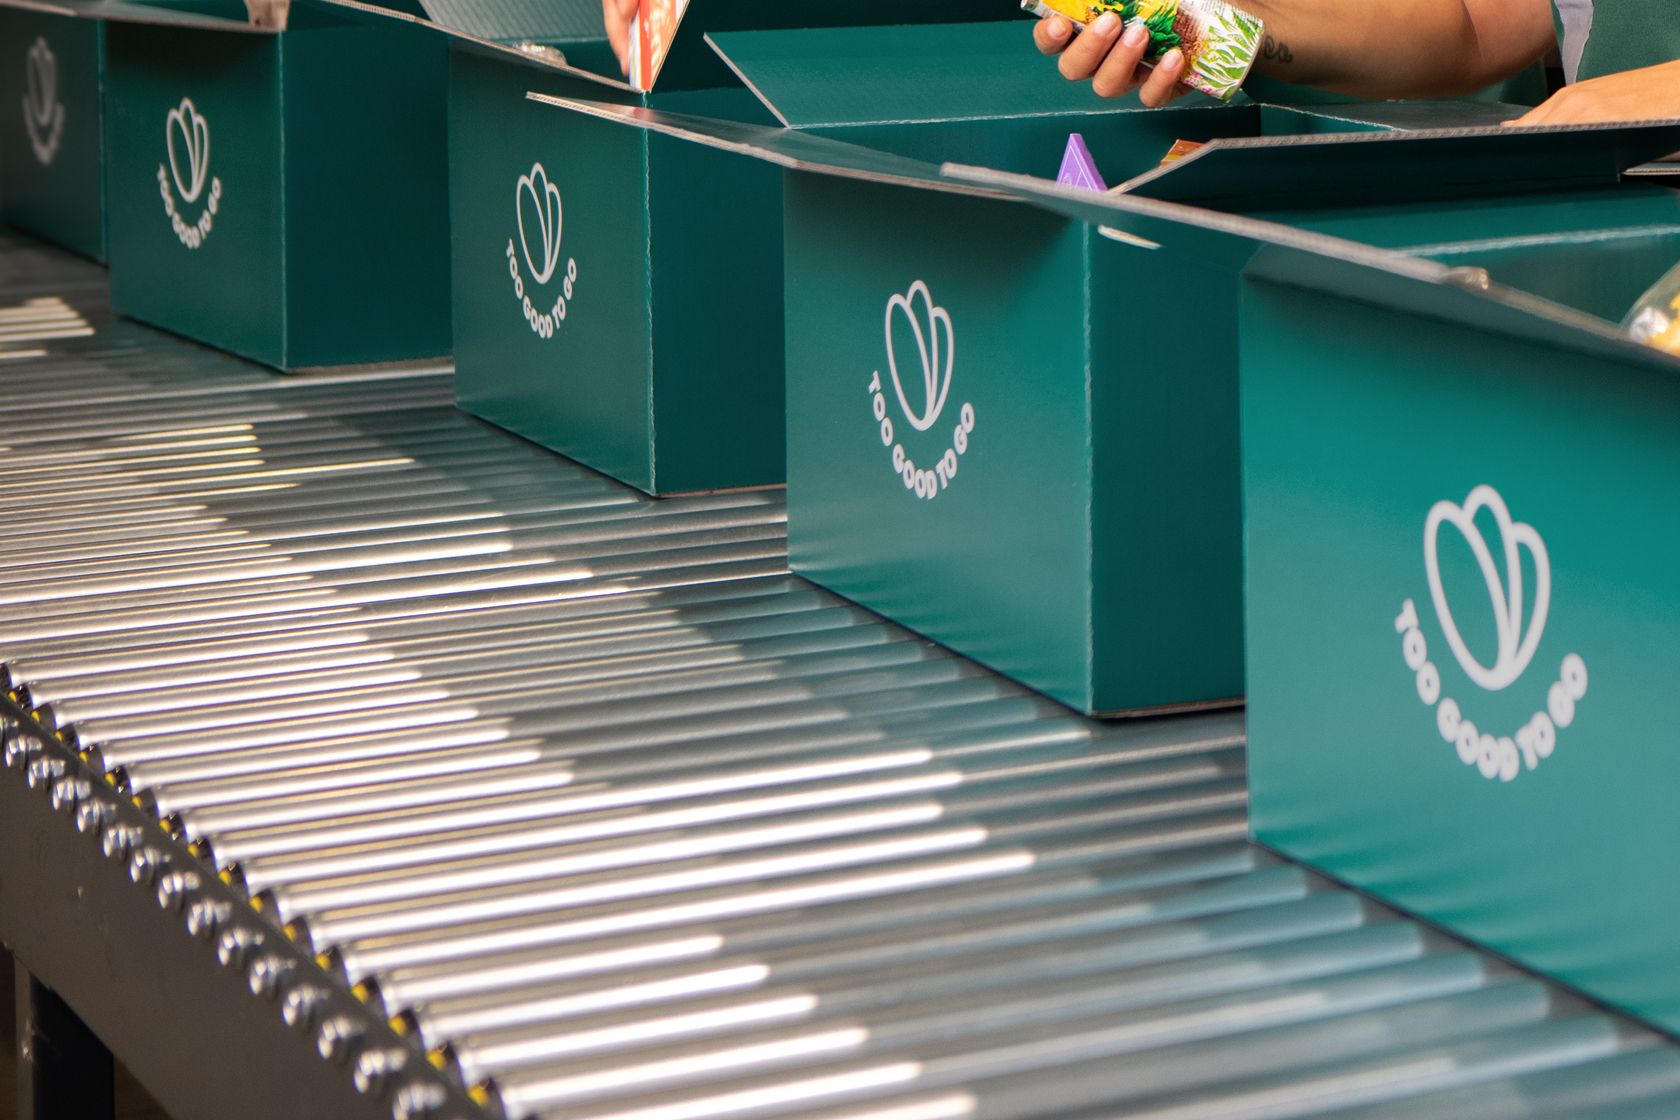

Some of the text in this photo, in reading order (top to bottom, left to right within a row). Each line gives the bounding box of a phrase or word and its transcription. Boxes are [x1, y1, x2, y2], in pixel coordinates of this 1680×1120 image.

[506, 238, 577, 339] TOO GOOD TO GO
[868, 370, 975, 500] TOO GOOD TO GO
[1394, 597, 1441, 706] TOO
[1515, 711, 1556, 770] TO
